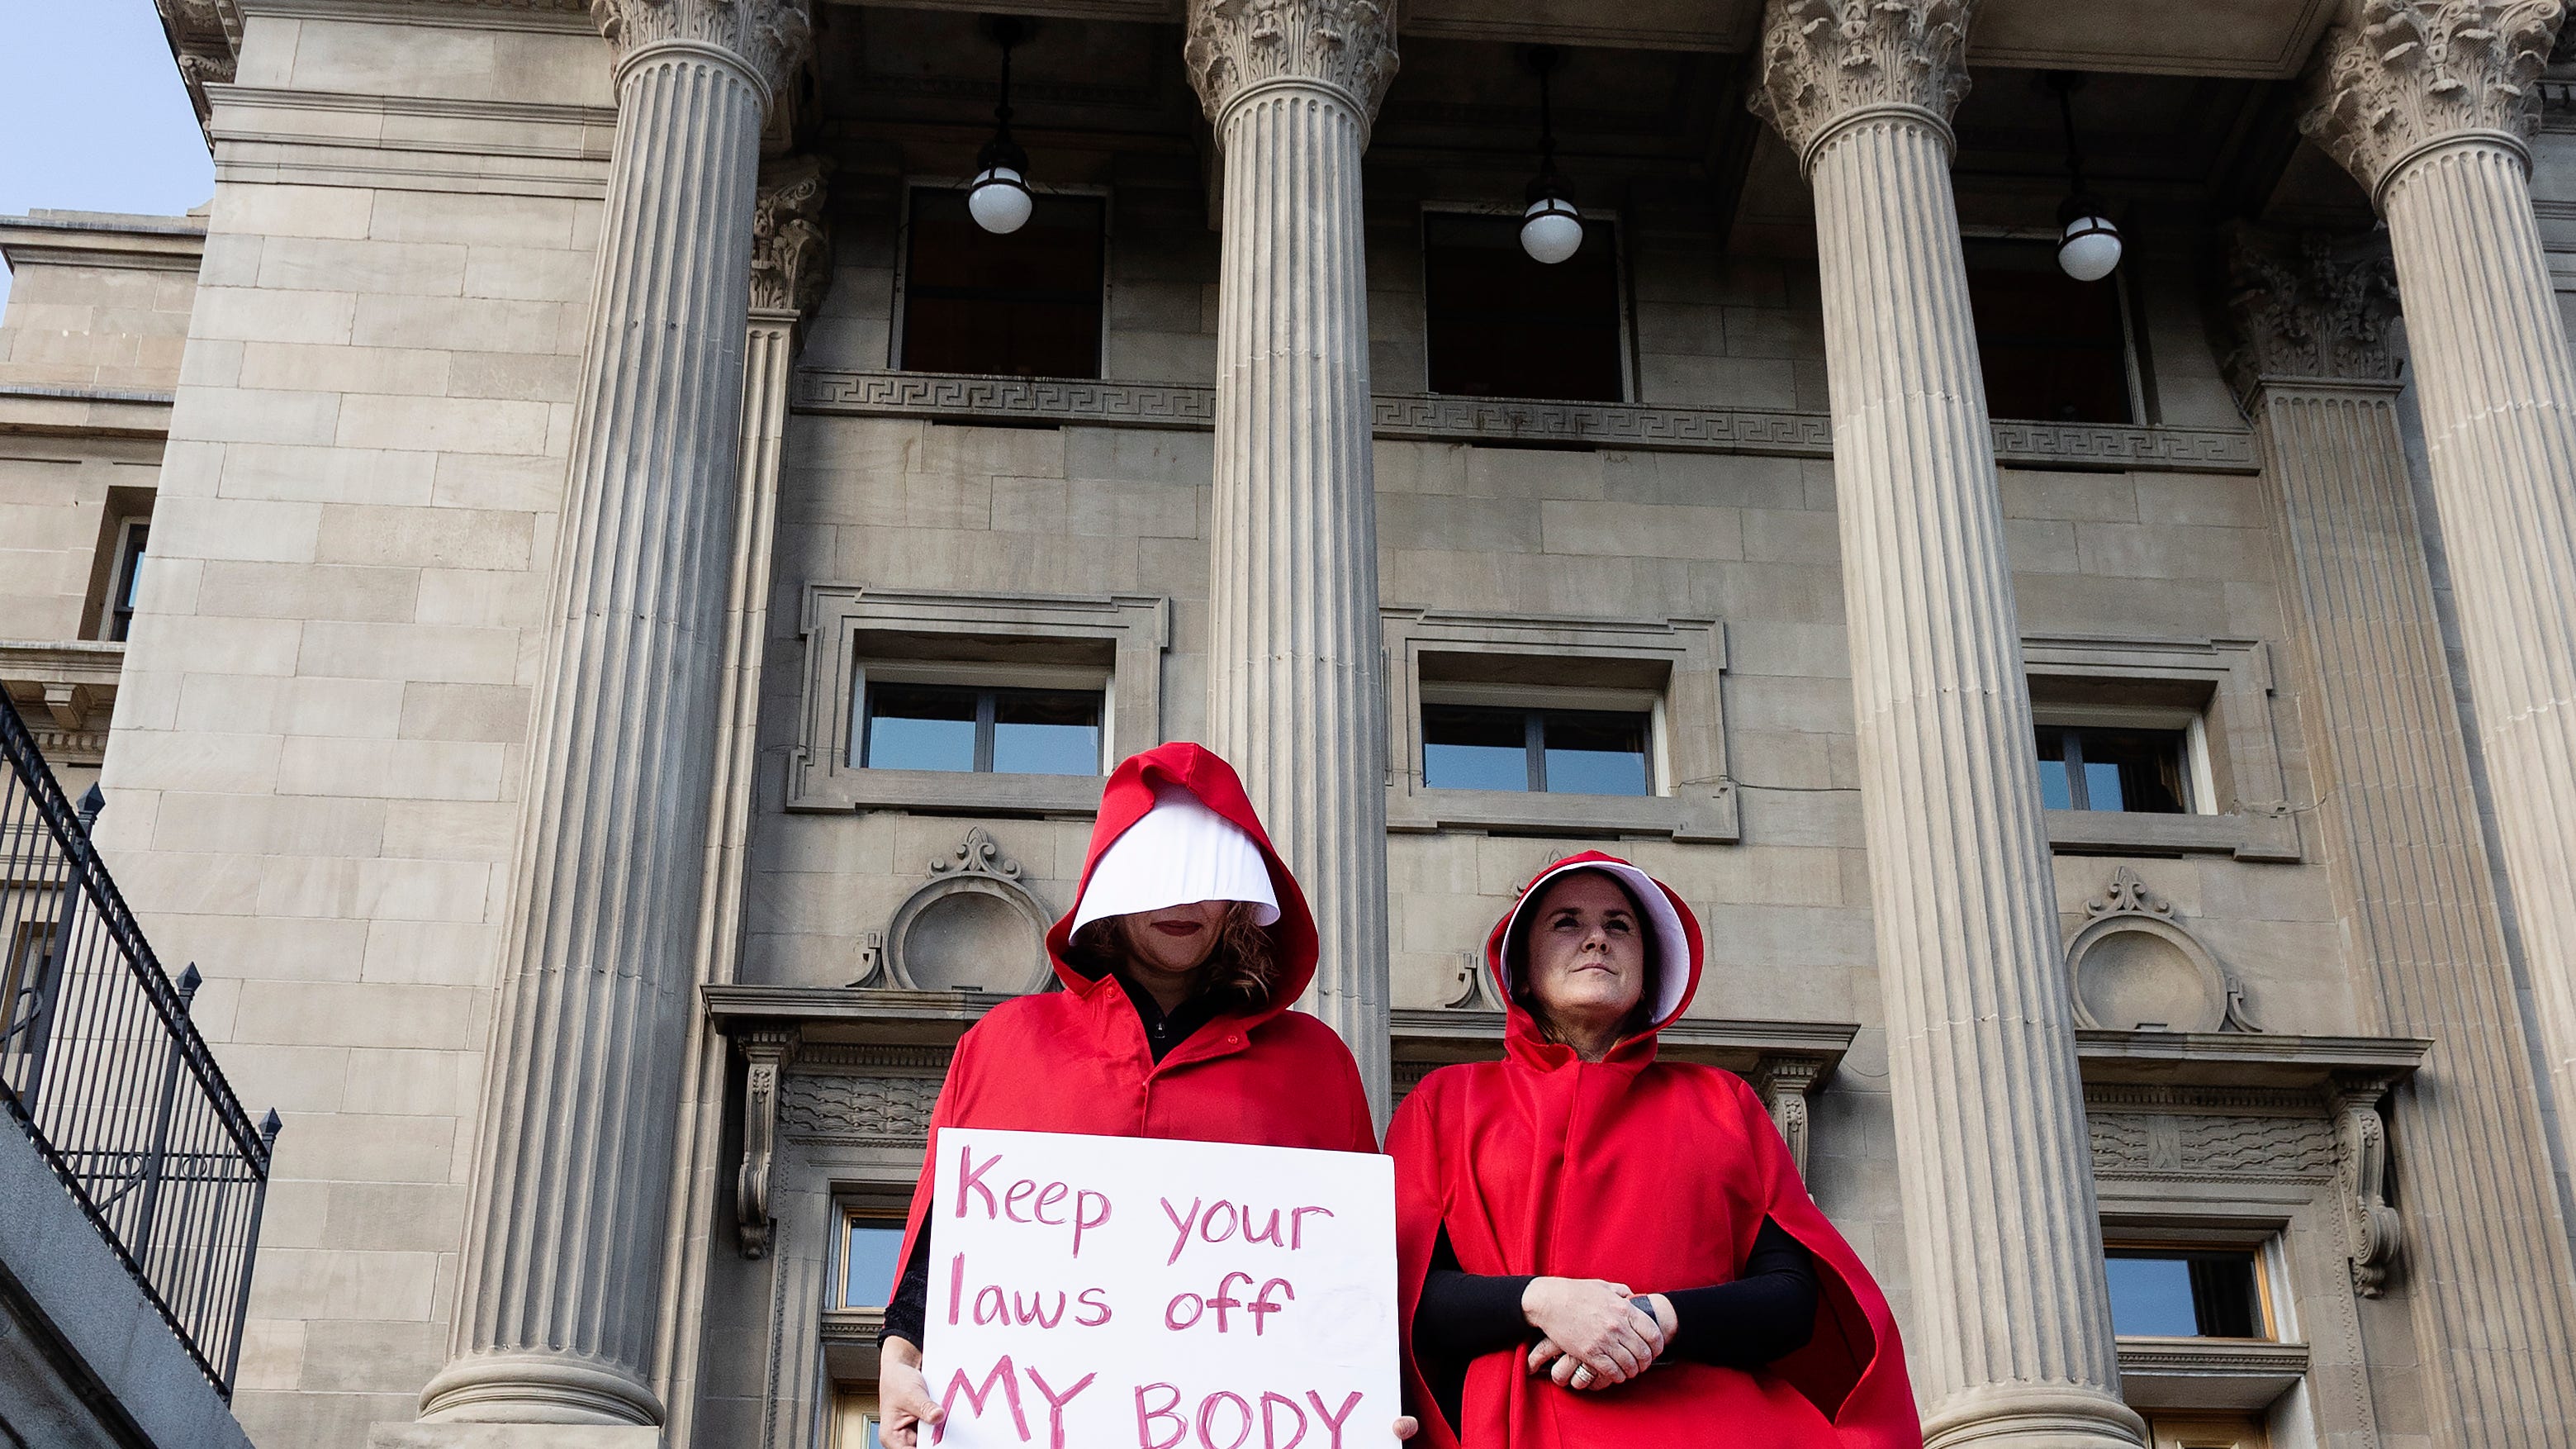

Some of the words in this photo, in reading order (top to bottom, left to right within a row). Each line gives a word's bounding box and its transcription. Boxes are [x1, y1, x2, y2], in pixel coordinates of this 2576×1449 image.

[956, 1145, 1112, 1258] Keep
[1160, 1195, 1335, 1266] your
[948, 1252, 1112, 1329] laws
[1165, 1271, 1295, 1336] off
[932, 1355, 1098, 1449] MY
[1134, 1381, 1364, 1449] BODY
